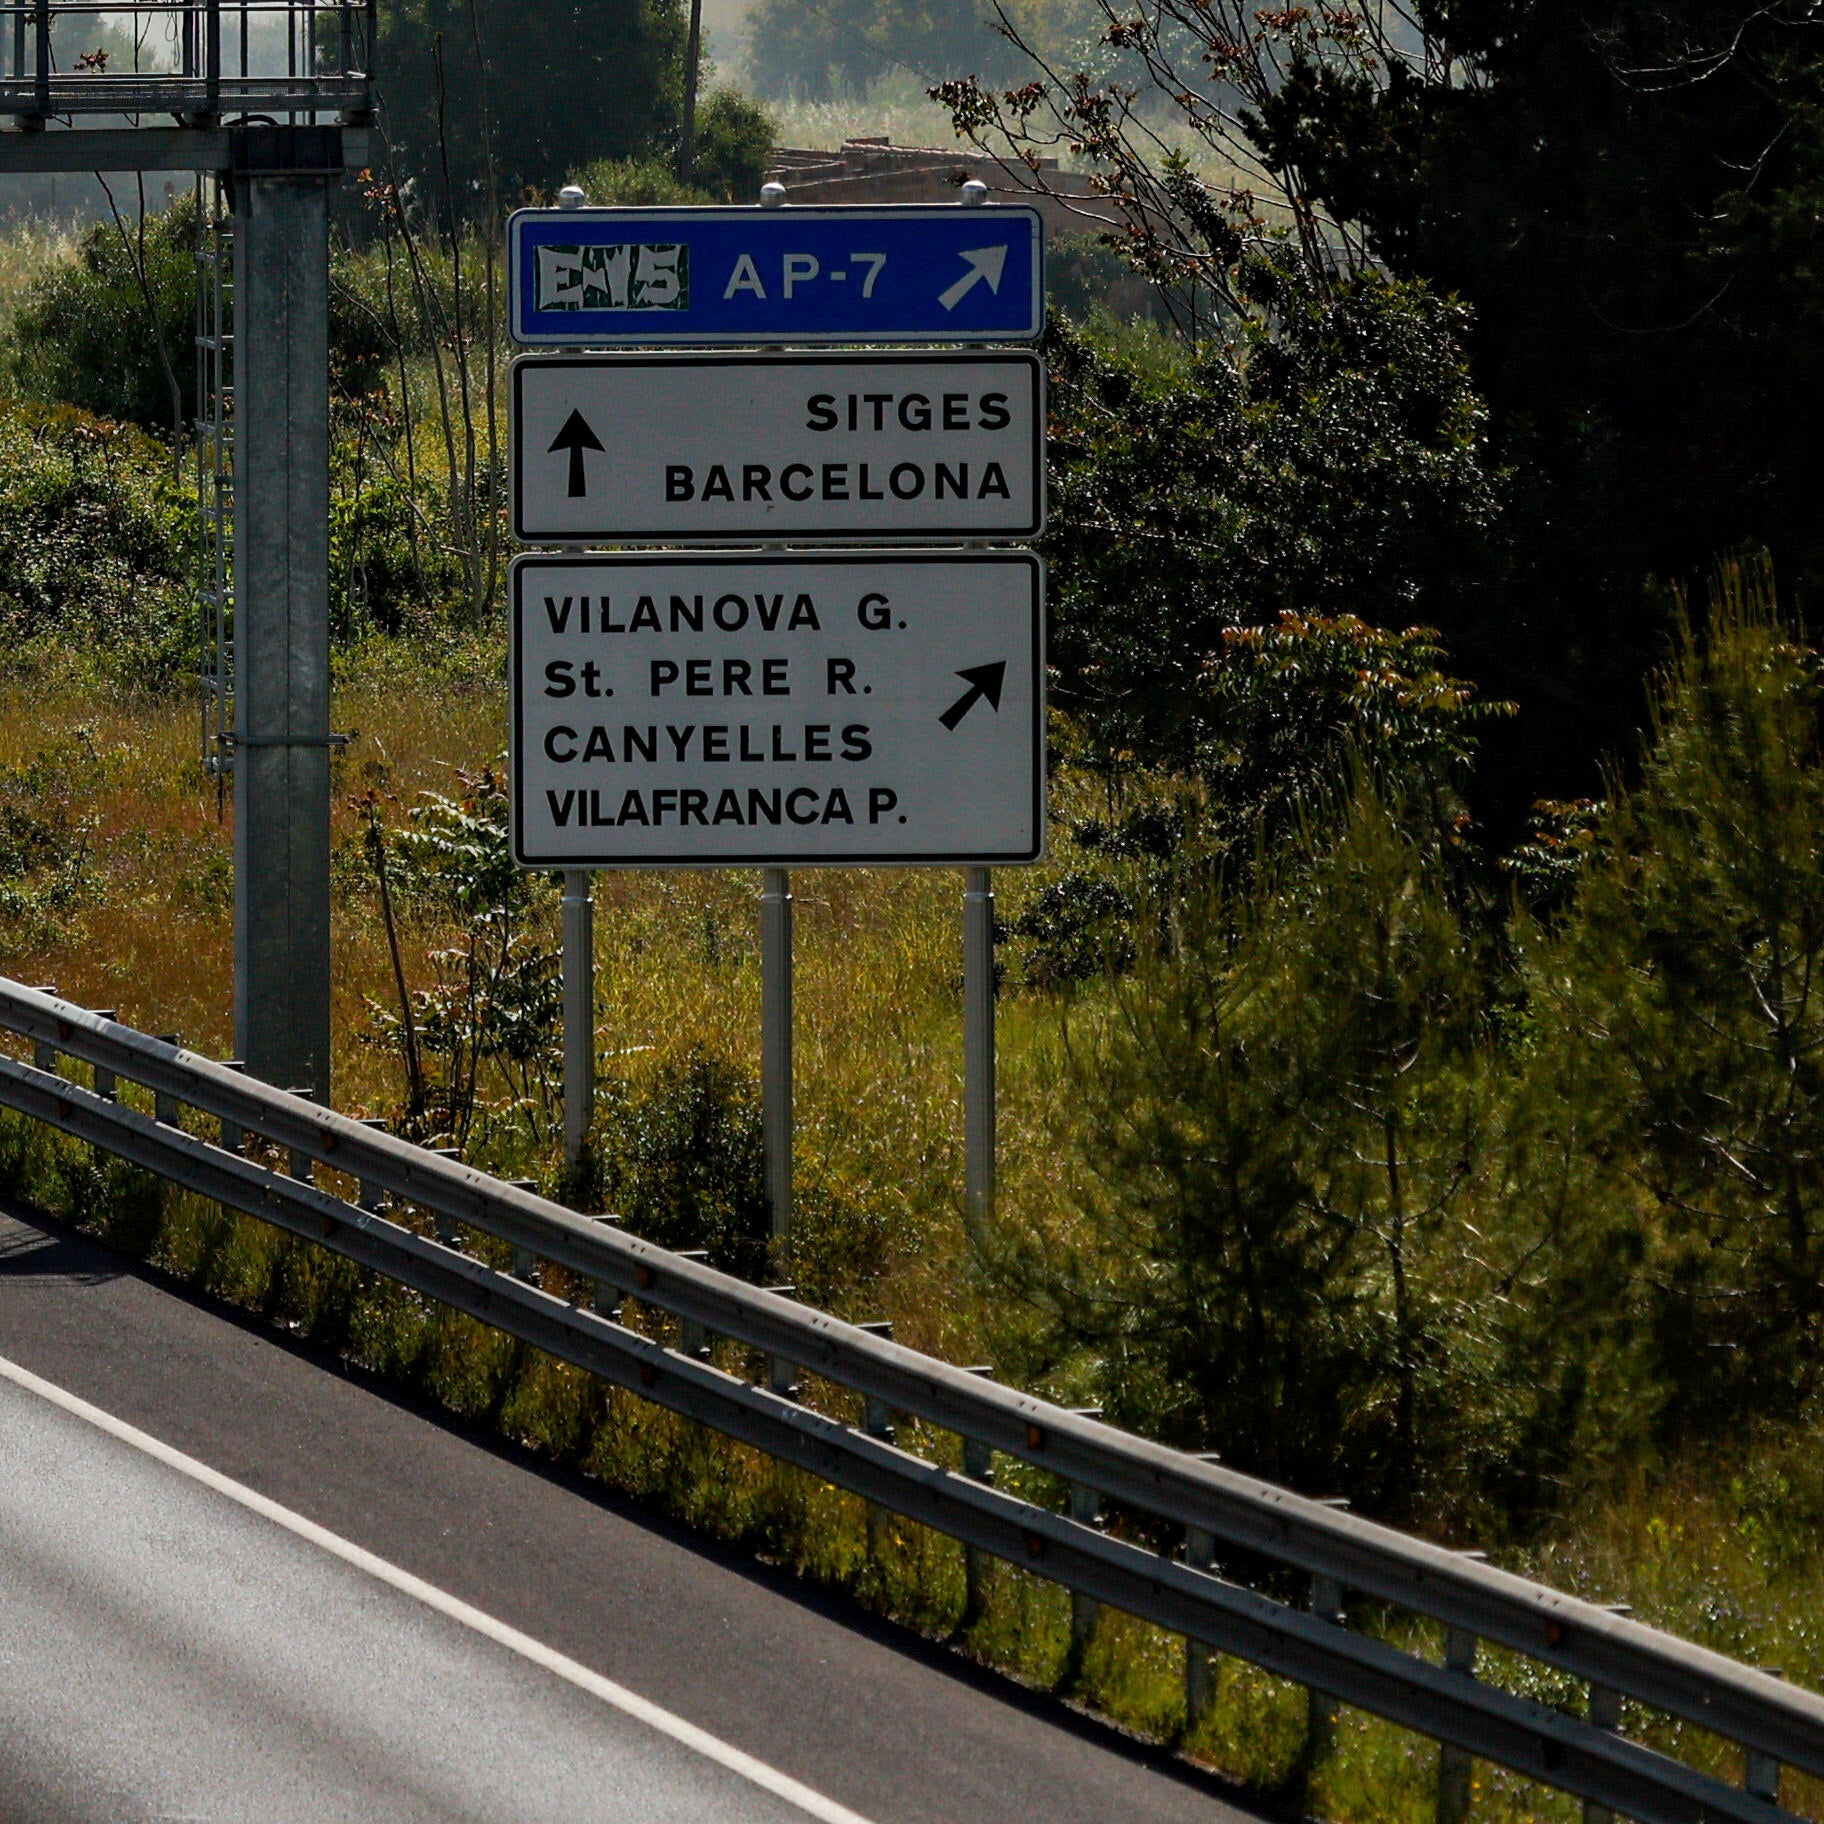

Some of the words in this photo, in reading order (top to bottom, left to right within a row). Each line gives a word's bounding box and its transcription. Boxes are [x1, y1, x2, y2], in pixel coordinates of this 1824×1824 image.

[538, 246, 682, 310] E-15
[724, 254, 885, 298] AP-7
[806, 393, 1011, 432] SITGES
[666, 462, 1011, 502] BARCELONA
[544, 594, 821, 633] VILANOVA
[858, 593, 907, 630] G.
[544, 661, 613, 698] St.
[651, 659, 790, 696] PERE
[827, 658, 871, 694] R.
[544, 724, 872, 763] CANYELLES
[546, 787, 854, 826] VILAFRANCA
[869, 788, 906, 824] P.
